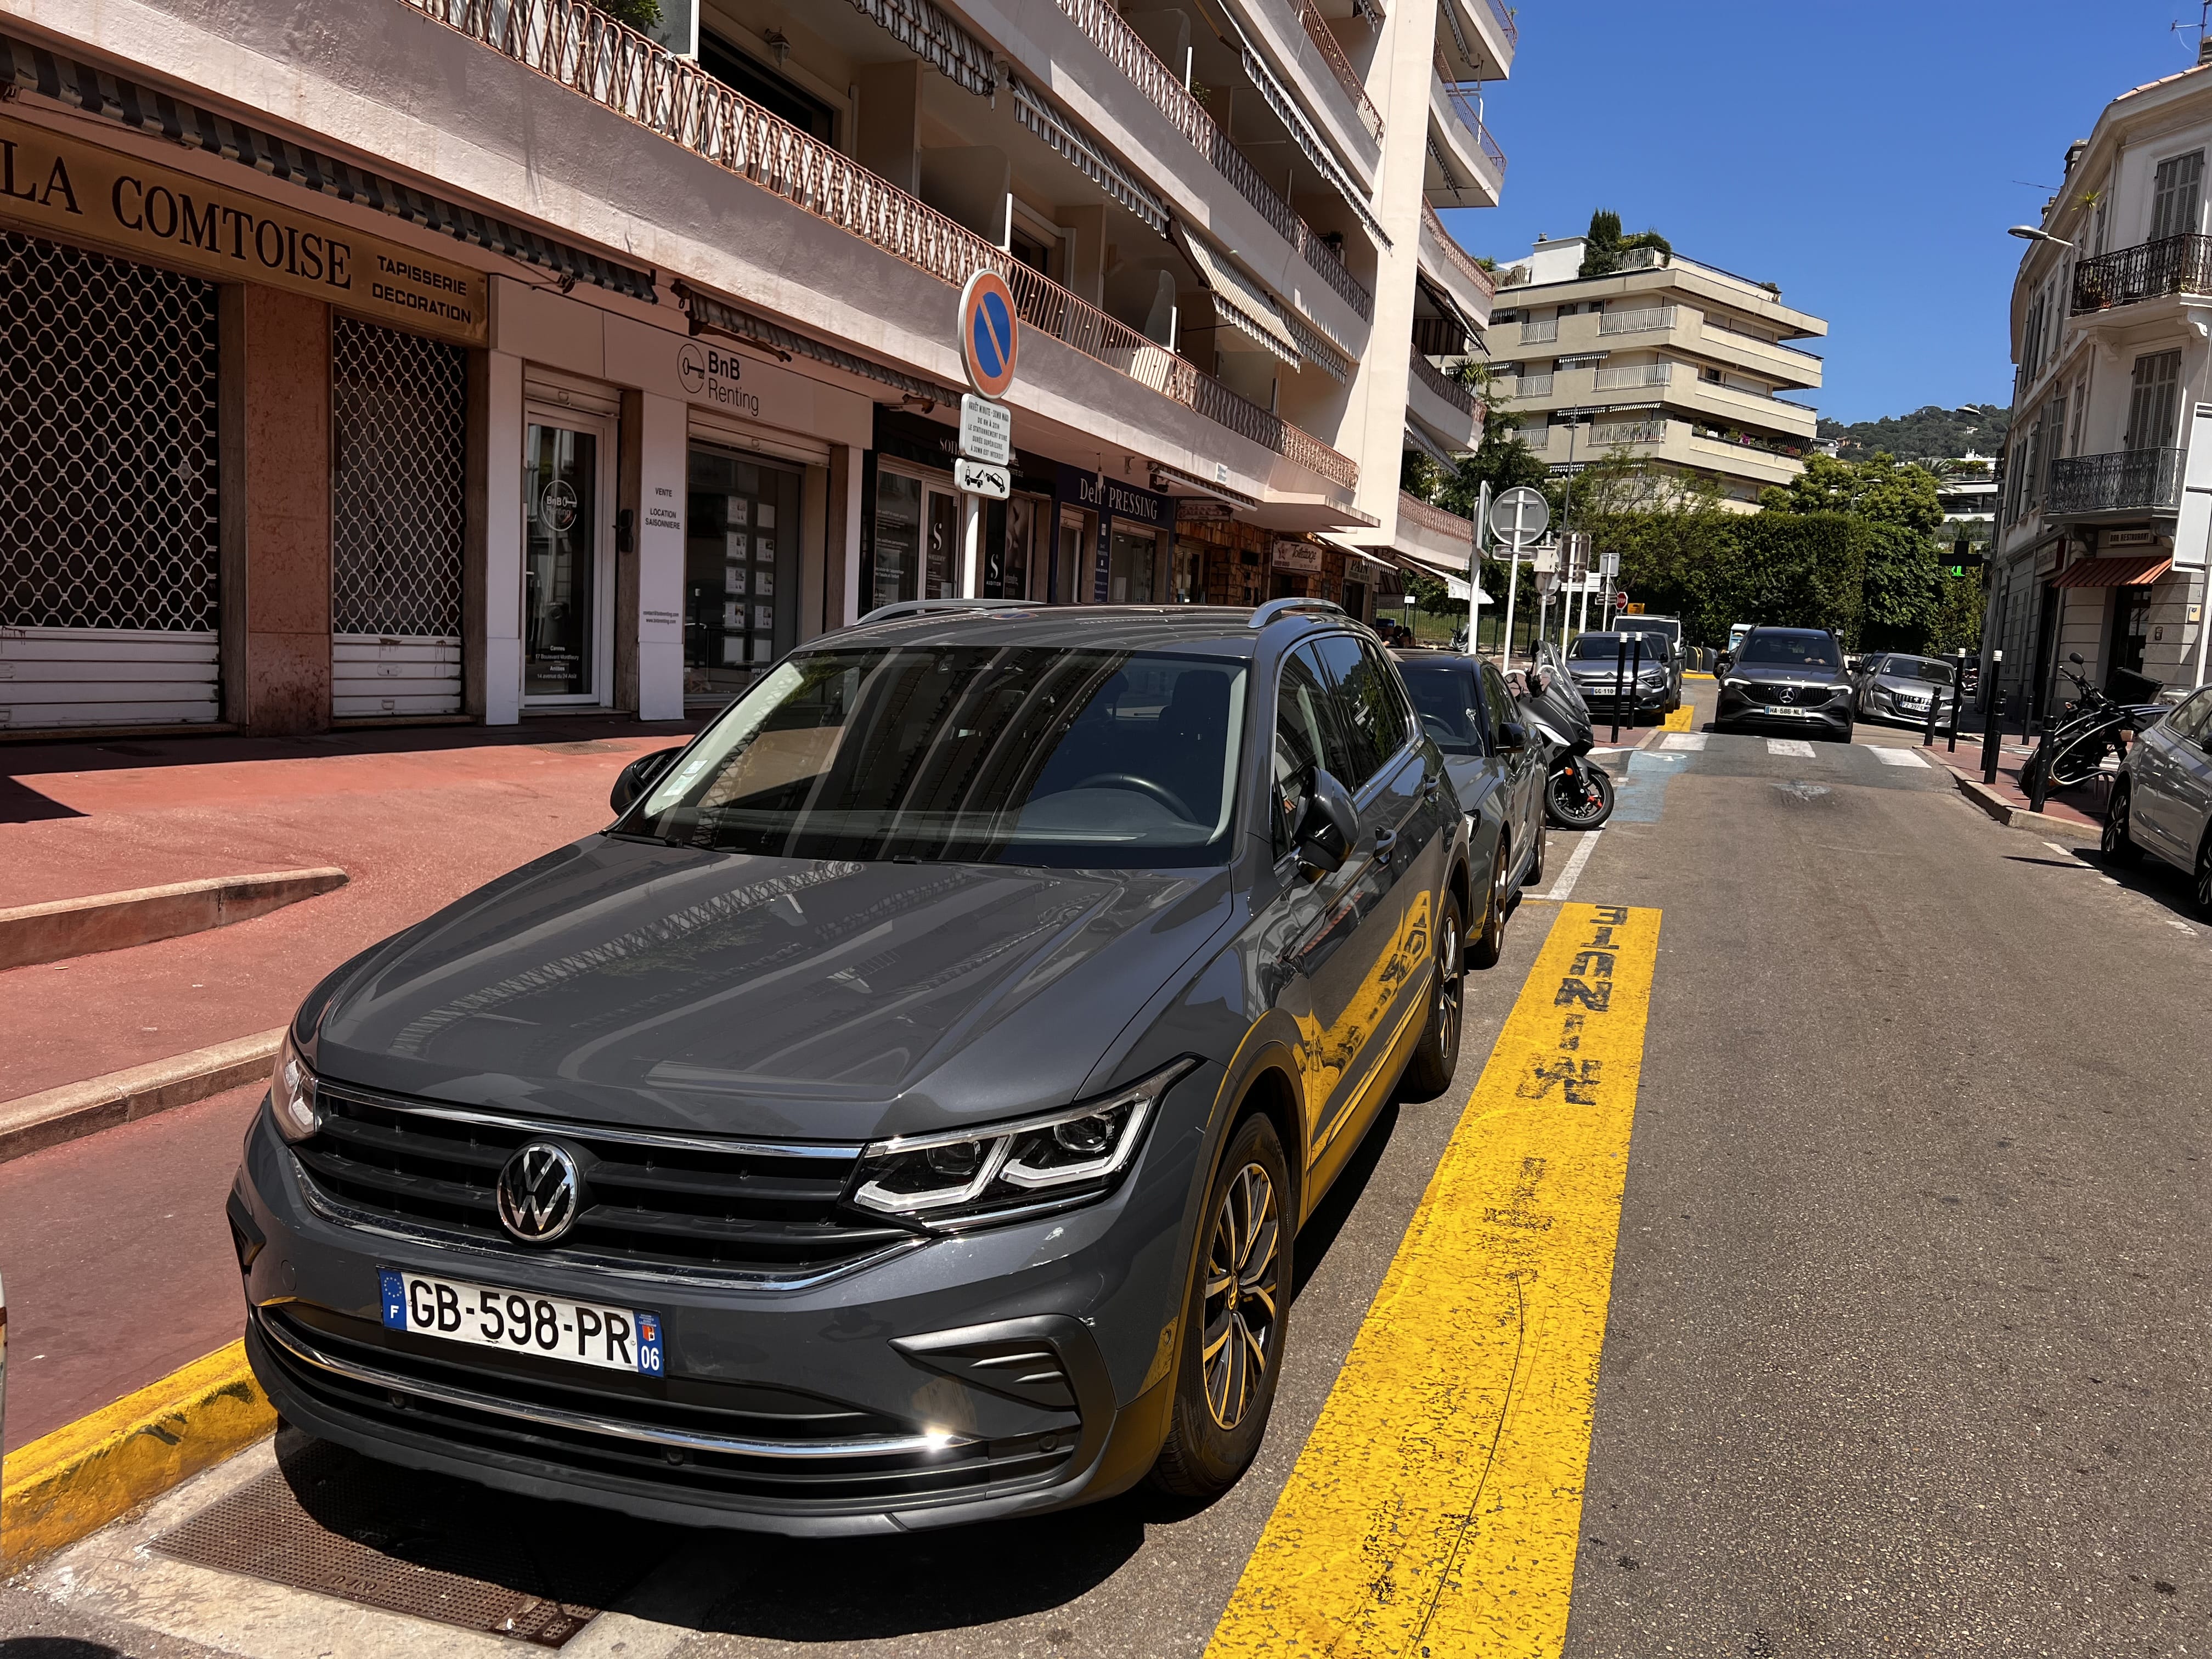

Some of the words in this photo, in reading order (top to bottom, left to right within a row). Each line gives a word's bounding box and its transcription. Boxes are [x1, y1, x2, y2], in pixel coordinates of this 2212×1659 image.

[0, 139, 83, 215] LA
[112, 175, 352, 290] COMTOISE
[377, 255, 467, 297] TAPISSERIE
[372, 282, 472, 324] DECORATION
[708, 350, 741, 381] BnB
[708, 377, 760, 417] Renting
[968, 401, 978, 412] ARRÊT
[979, 405, 990, 416] MINUTE
[973, 425, 998, 438] STATIONNEMENT
[990, 451, 1003, 460] INTERDIT
[655, 487, 672, 497] VENTE
[546, 496, 562, 506] BnB
[1108, 487, 1157, 520] PRESSING
[650, 508, 676, 518] LOCATION
[645, 517, 680, 529] SAISONNIERE
[2120, 533, 2149, 541] RESTAURANT
[390, 1305, 400, 1319] F
[410, 1279, 633, 1364] GB-598-PR
[641, 1345, 659, 1370] 06
